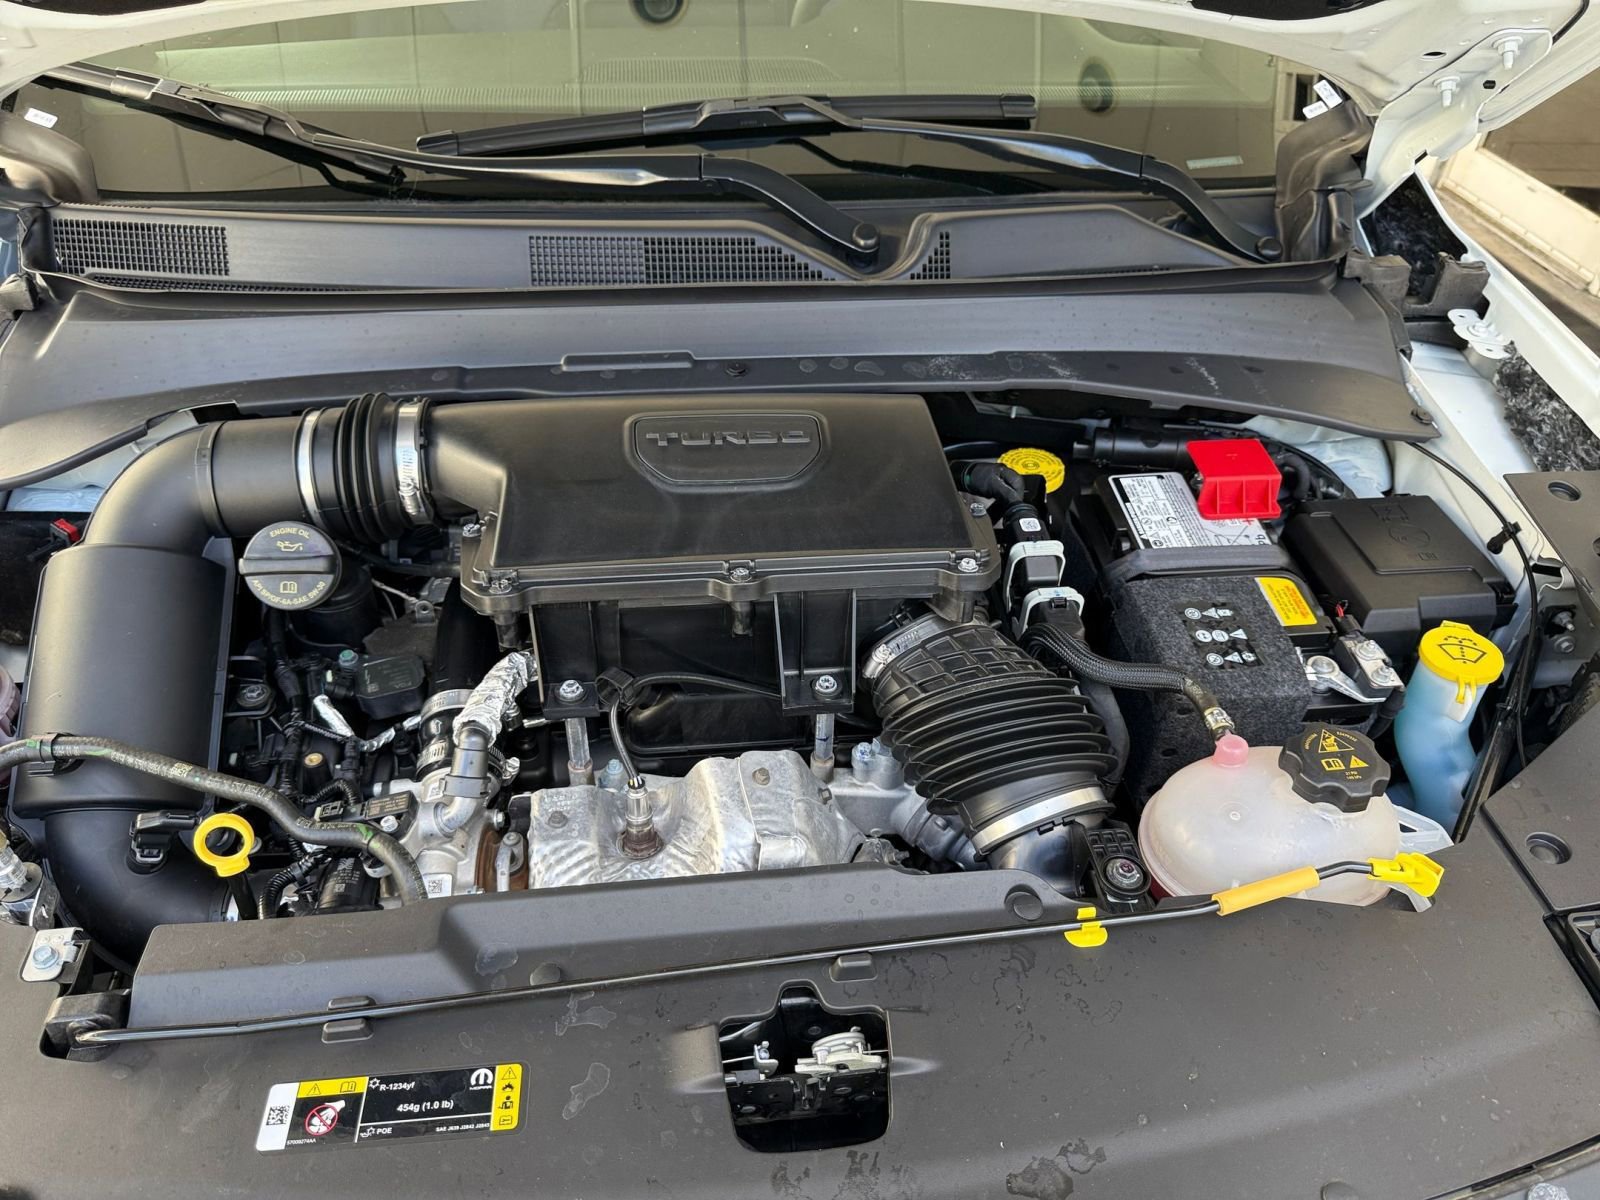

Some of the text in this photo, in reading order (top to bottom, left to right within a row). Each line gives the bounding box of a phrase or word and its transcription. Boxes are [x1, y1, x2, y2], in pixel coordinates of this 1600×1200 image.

[646, 430, 811, 447] TURBO
[270, 528, 311, 539] ENGINE OIL
[252, 579, 262, 592] API
[308, 581, 326, 598] 5W-30
[380, 1081, 416, 1092] R-1234yf
[396, 1100, 454, 1113] 454g (1.0 lb)
[376, 1127, 392, 1135] POE
